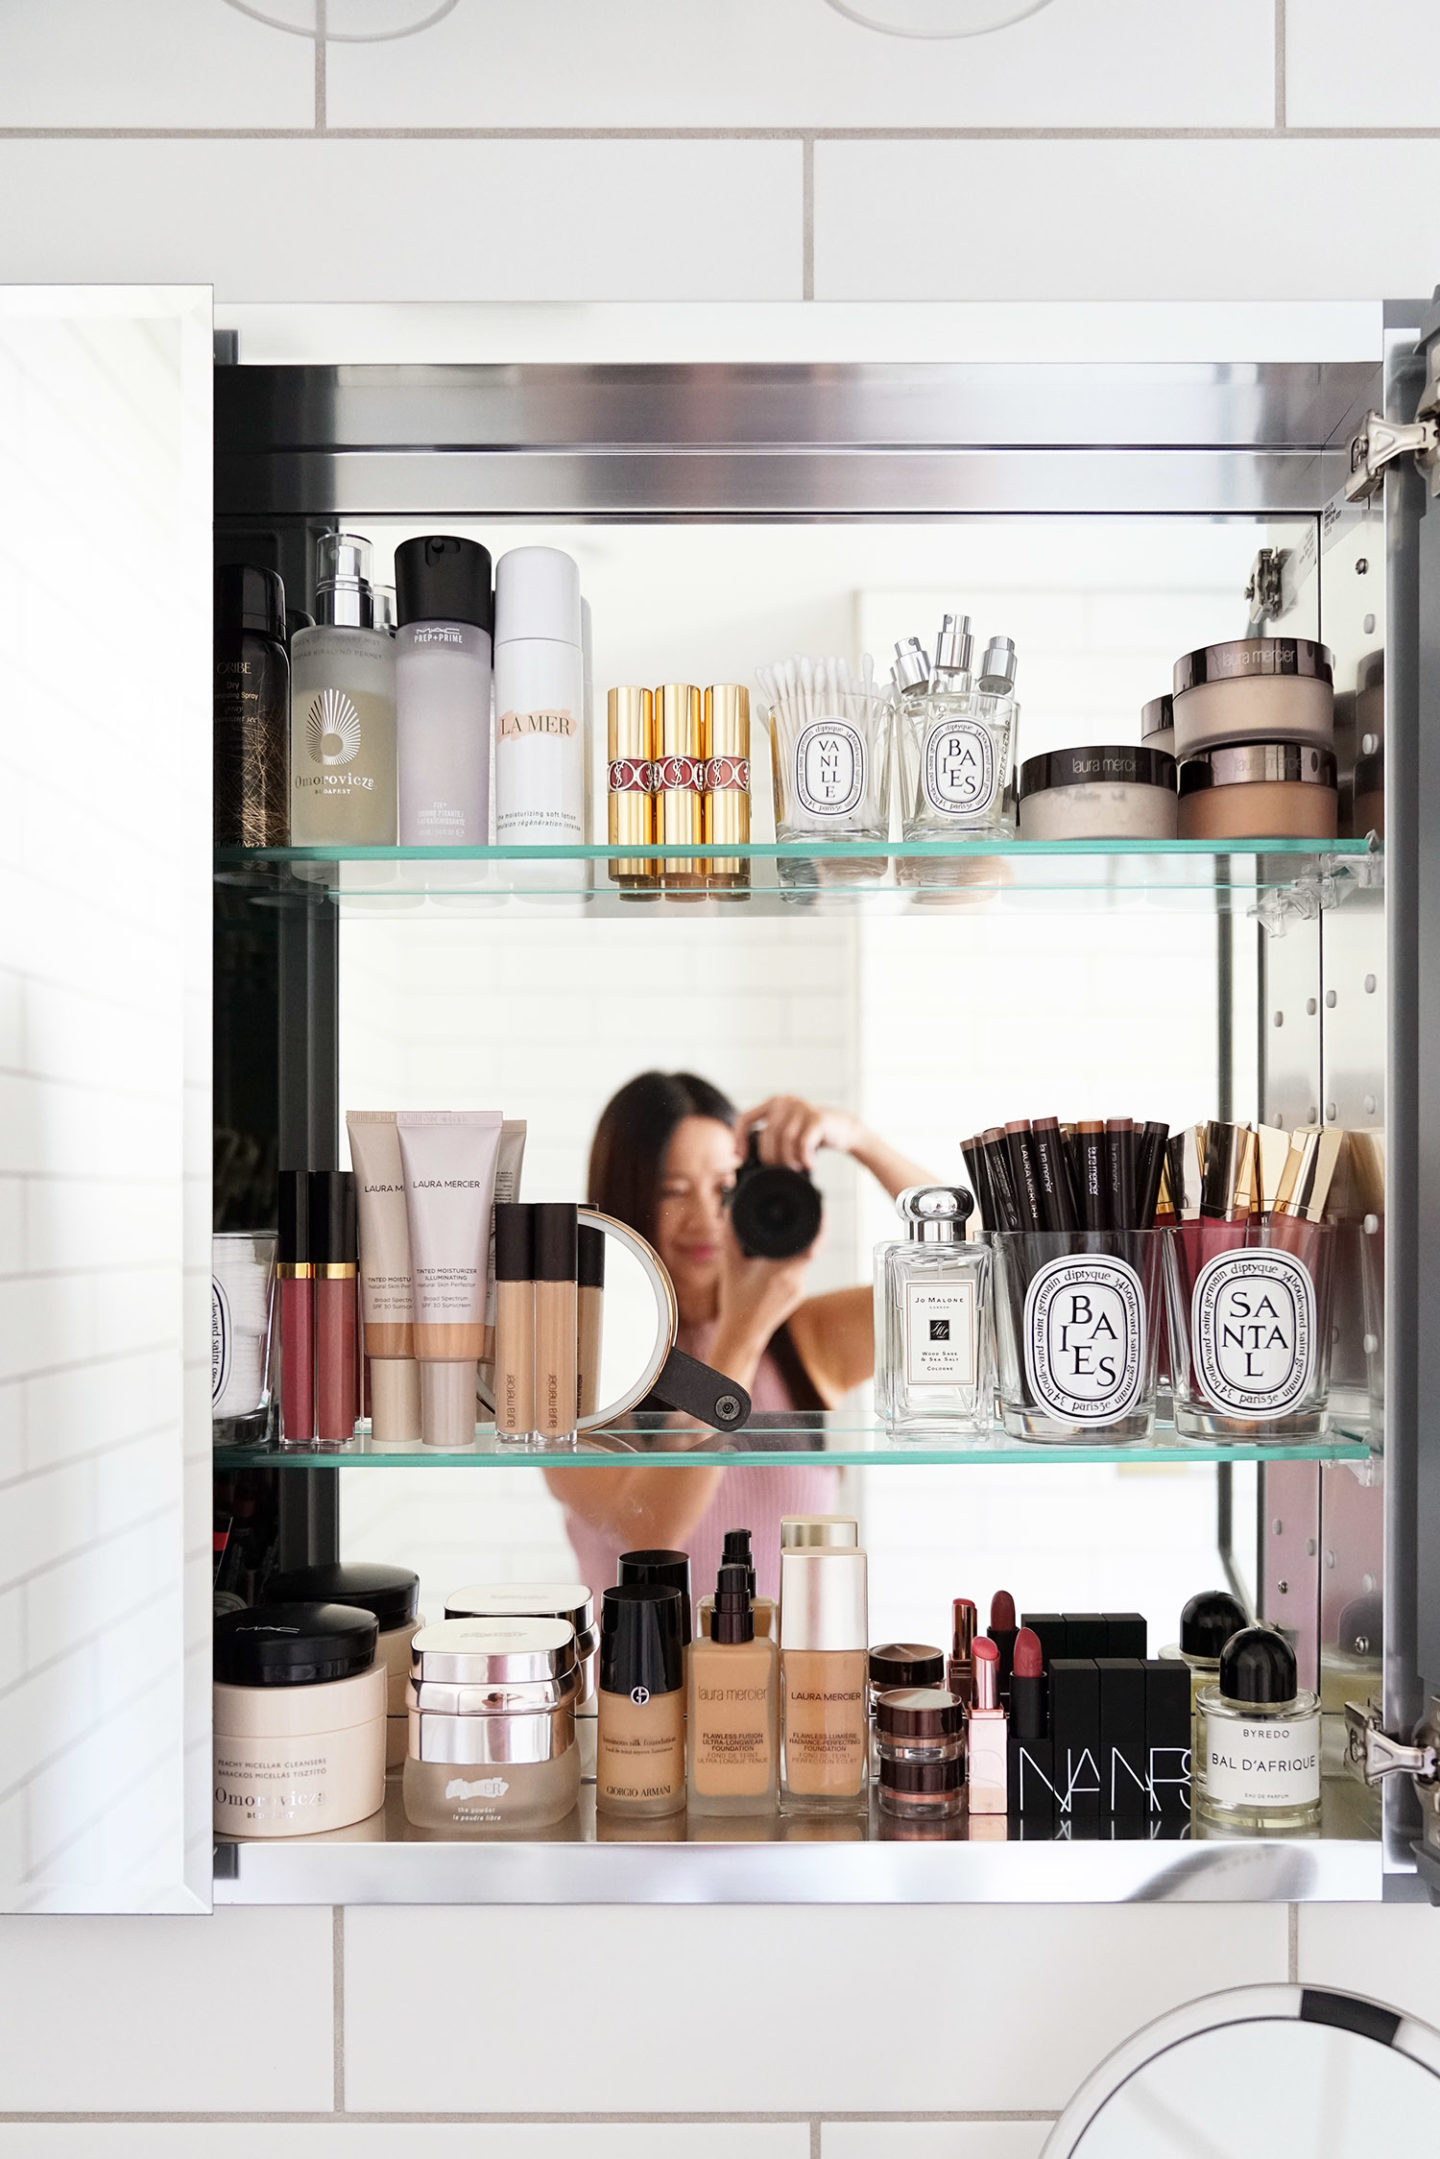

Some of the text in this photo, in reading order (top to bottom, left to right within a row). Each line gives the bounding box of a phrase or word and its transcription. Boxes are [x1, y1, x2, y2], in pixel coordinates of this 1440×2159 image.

[414, 633, 463, 644] PREP+PRIME
[1252, 646, 1296, 664] mercier
[241, 692, 258, 700] Spray
[501, 715, 570, 736] LA MER
[1072, 758, 1100, 774] laura
[413, 1180, 480, 1188] LAURA MERCIER
[1020, 1144, 1038, 1218] LAURA MERCIER
[364, 1184, 393, 1193] LAURA
[1231, 1264, 1278, 1274] diptyque
[1064, 1270, 1111, 1282] diptyque
[1202, 1310, 1211, 1334] saint
[1036, 1318, 1044, 1342] saint
[505, 1408, 516, 1428] laura
[698, 1686, 766, 1700] laura mercier
[792, 1692, 861, 1700] LAURA MERCIER
[1243, 1729, 1290, 1738] BYREDO
[1212, 1753, 1316, 1772] BAL D'AFRIQUE
[606, 1785, 671, 1797] GIORGIO ARMANI
